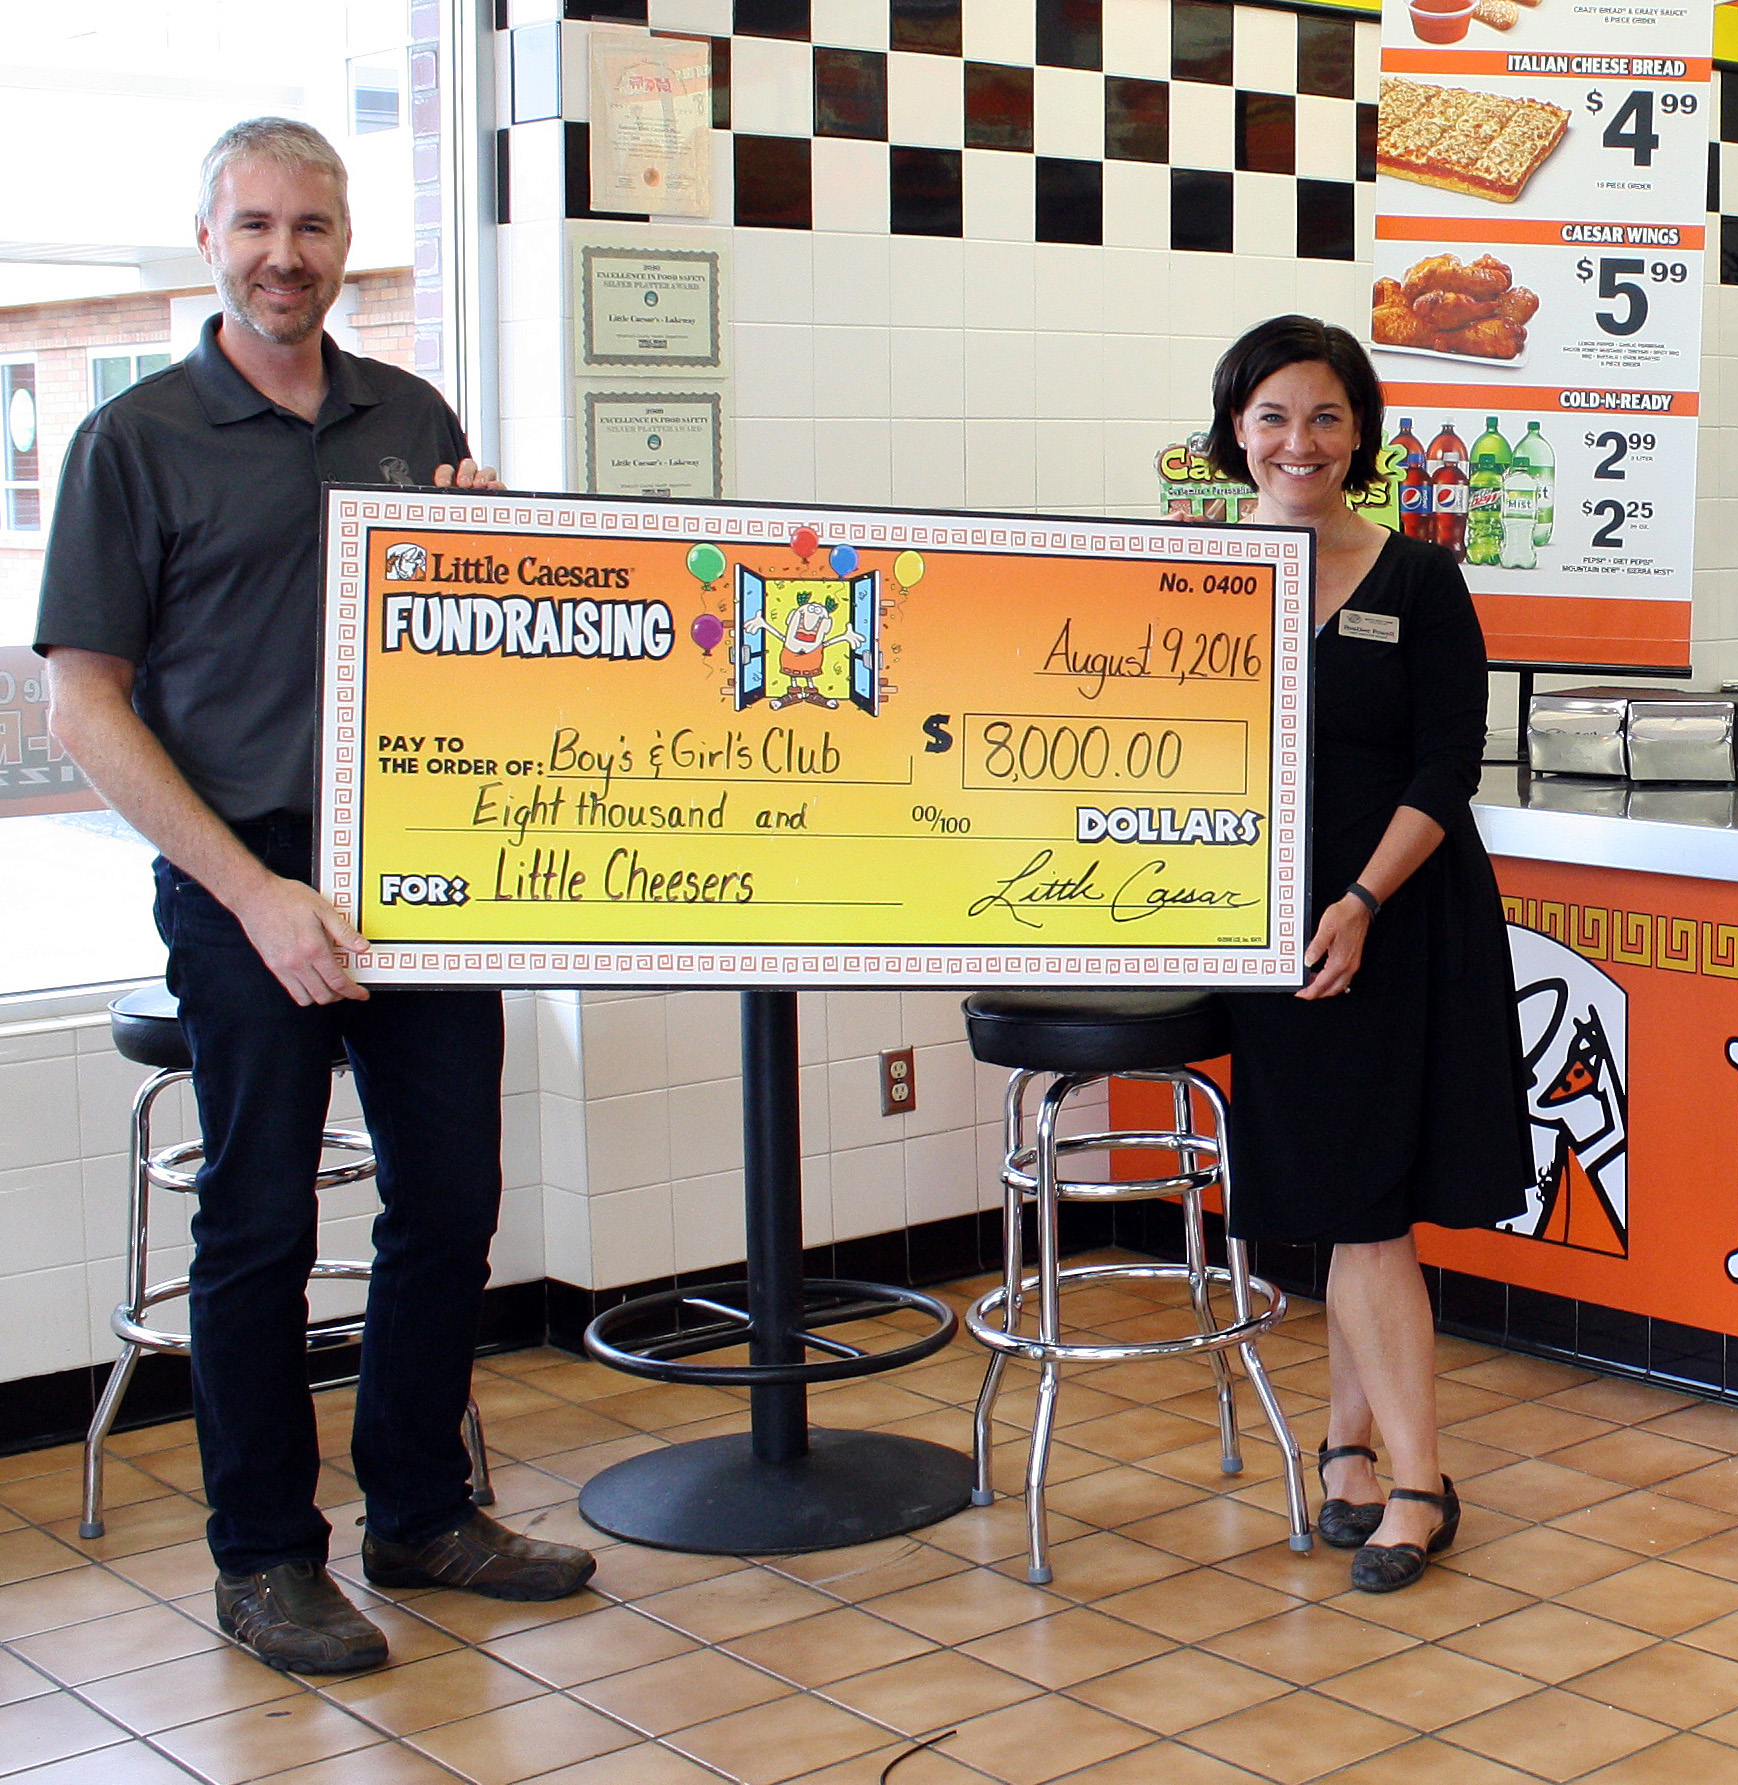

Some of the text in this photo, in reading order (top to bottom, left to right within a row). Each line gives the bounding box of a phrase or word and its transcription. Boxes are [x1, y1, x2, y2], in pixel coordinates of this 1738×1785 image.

[1507, 54, 1687, 77] ITALIAN CHEESE BREAD
[1561, 224, 1680, 246] CAESAR WINGS
[1560, 391, 1672, 411] COLD-N-READY
[1507, 500, 1532, 509] Mist
[431, 553, 630, 589] Little Caesars
[1159, 572, 1257, 596] No. 0400
[382, 592, 676, 661] FUNDRAISING
[1043, 618, 1153, 699] August
[379, 735, 464, 753] PAY TO
[922, 713, 954, 754] $
[379, 757, 544, 777] THE ORDER OF:
[548, 727, 633, 801] Boy's
[763, 726, 841, 775] Club
[982, 720, 1182, 784] 8,000.00
[472, 782, 808, 847] Eight thousand and
[1076, 806, 1265, 846] DOLLARS
[380, 874, 471, 907] FOR:
[494, 847, 754, 904] Little Cheesers
